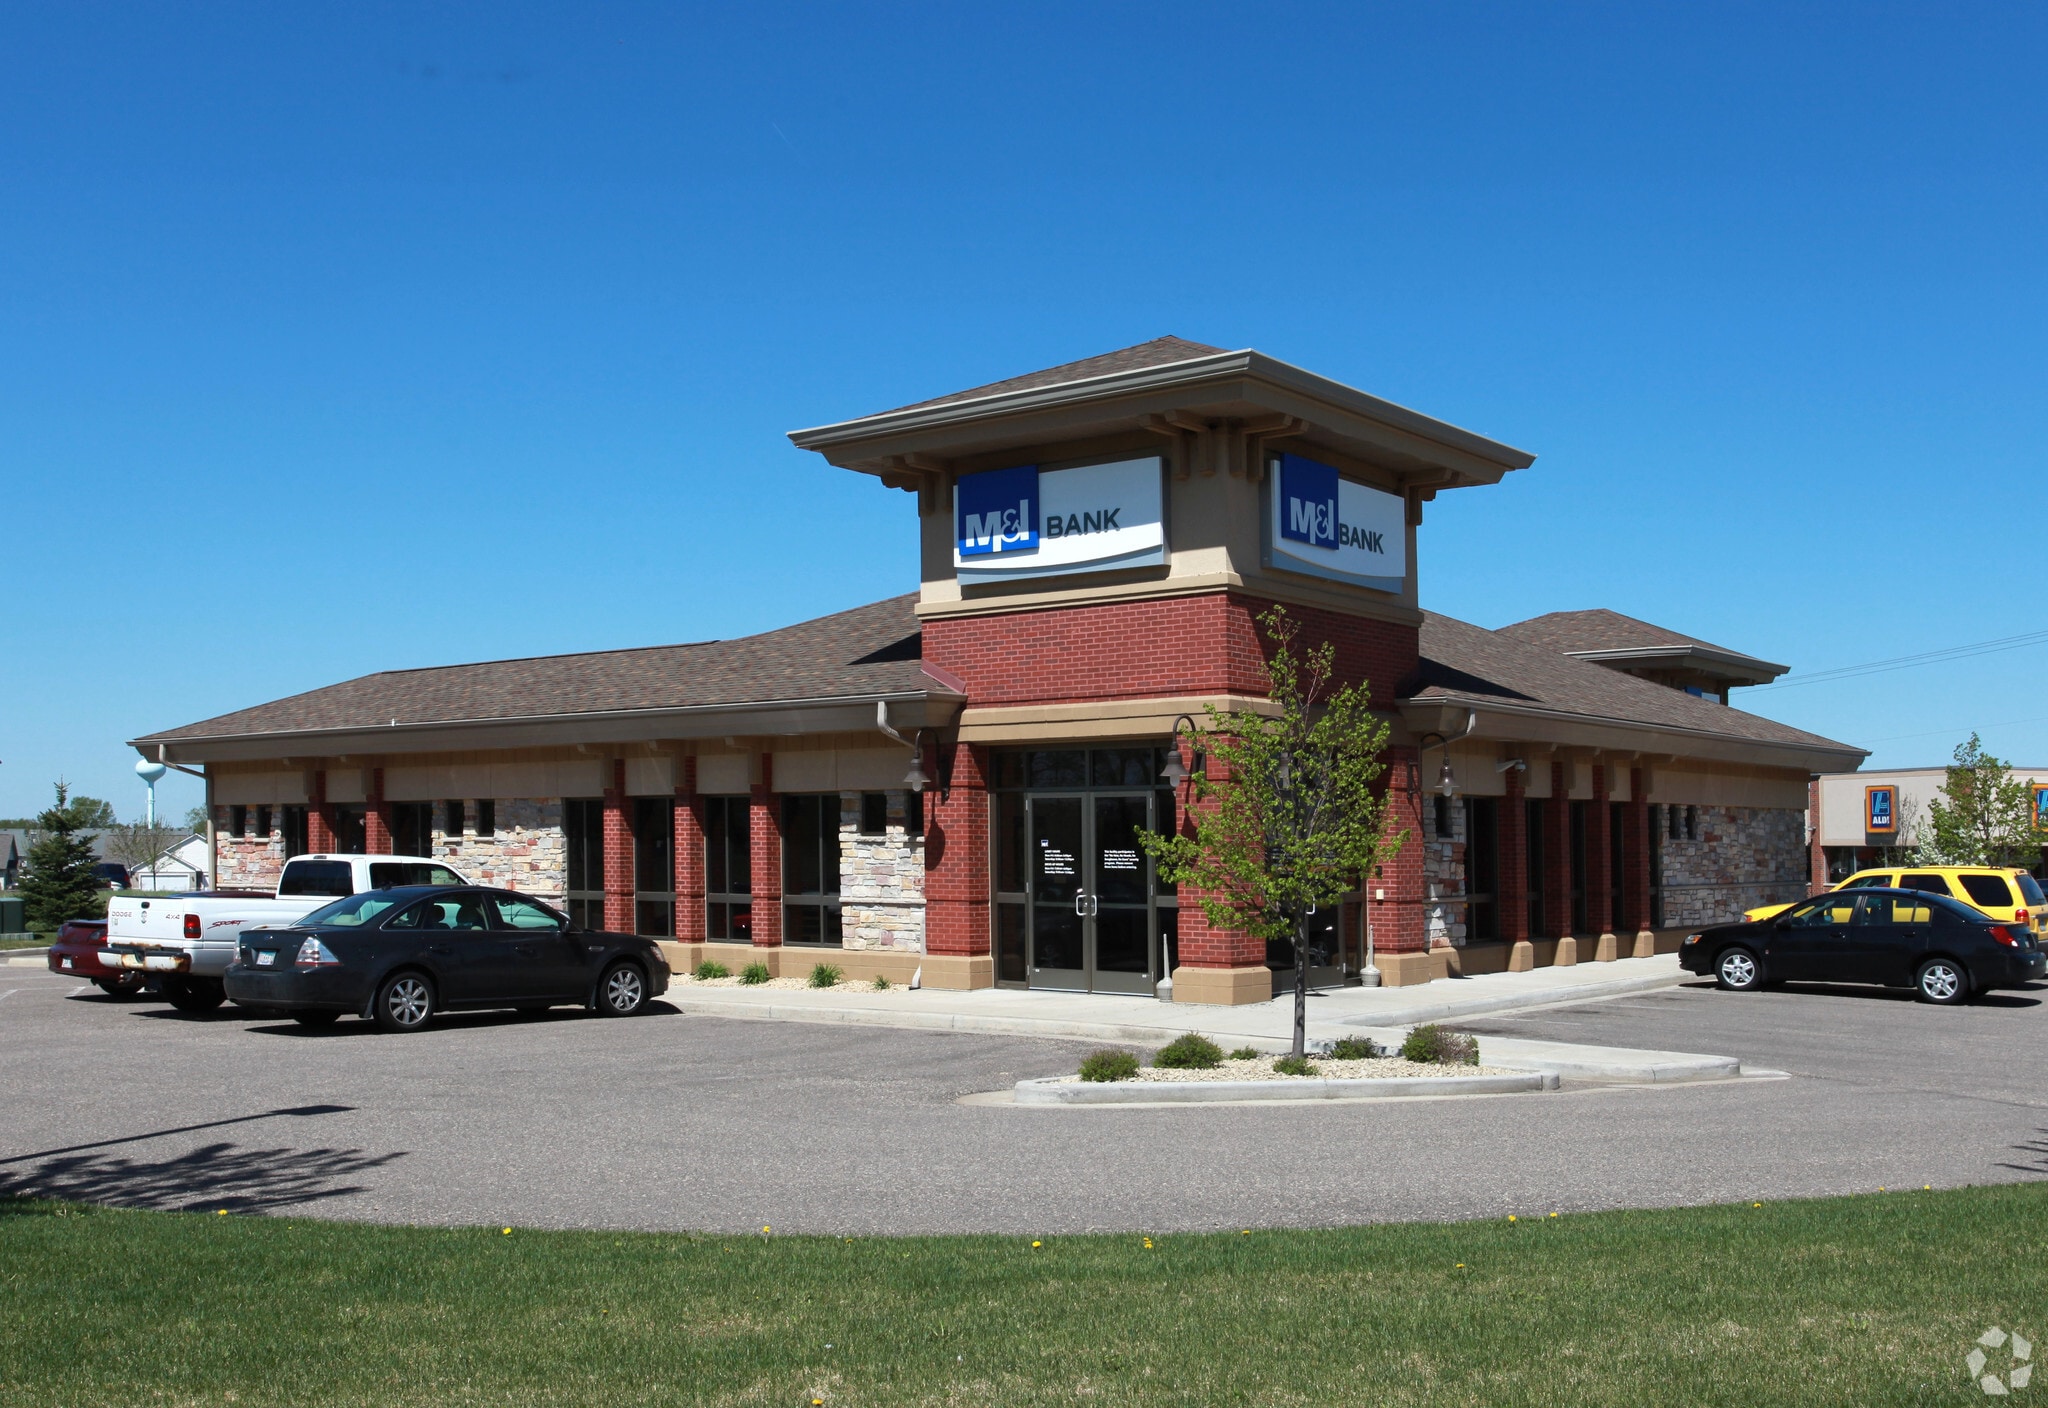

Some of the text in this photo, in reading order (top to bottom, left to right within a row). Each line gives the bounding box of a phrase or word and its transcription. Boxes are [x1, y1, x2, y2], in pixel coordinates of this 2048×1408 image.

[1046, 508, 1121, 539] BANK
[1339, 523, 1384, 554] BANK
[1872, 815, 1890, 825] ALDI
